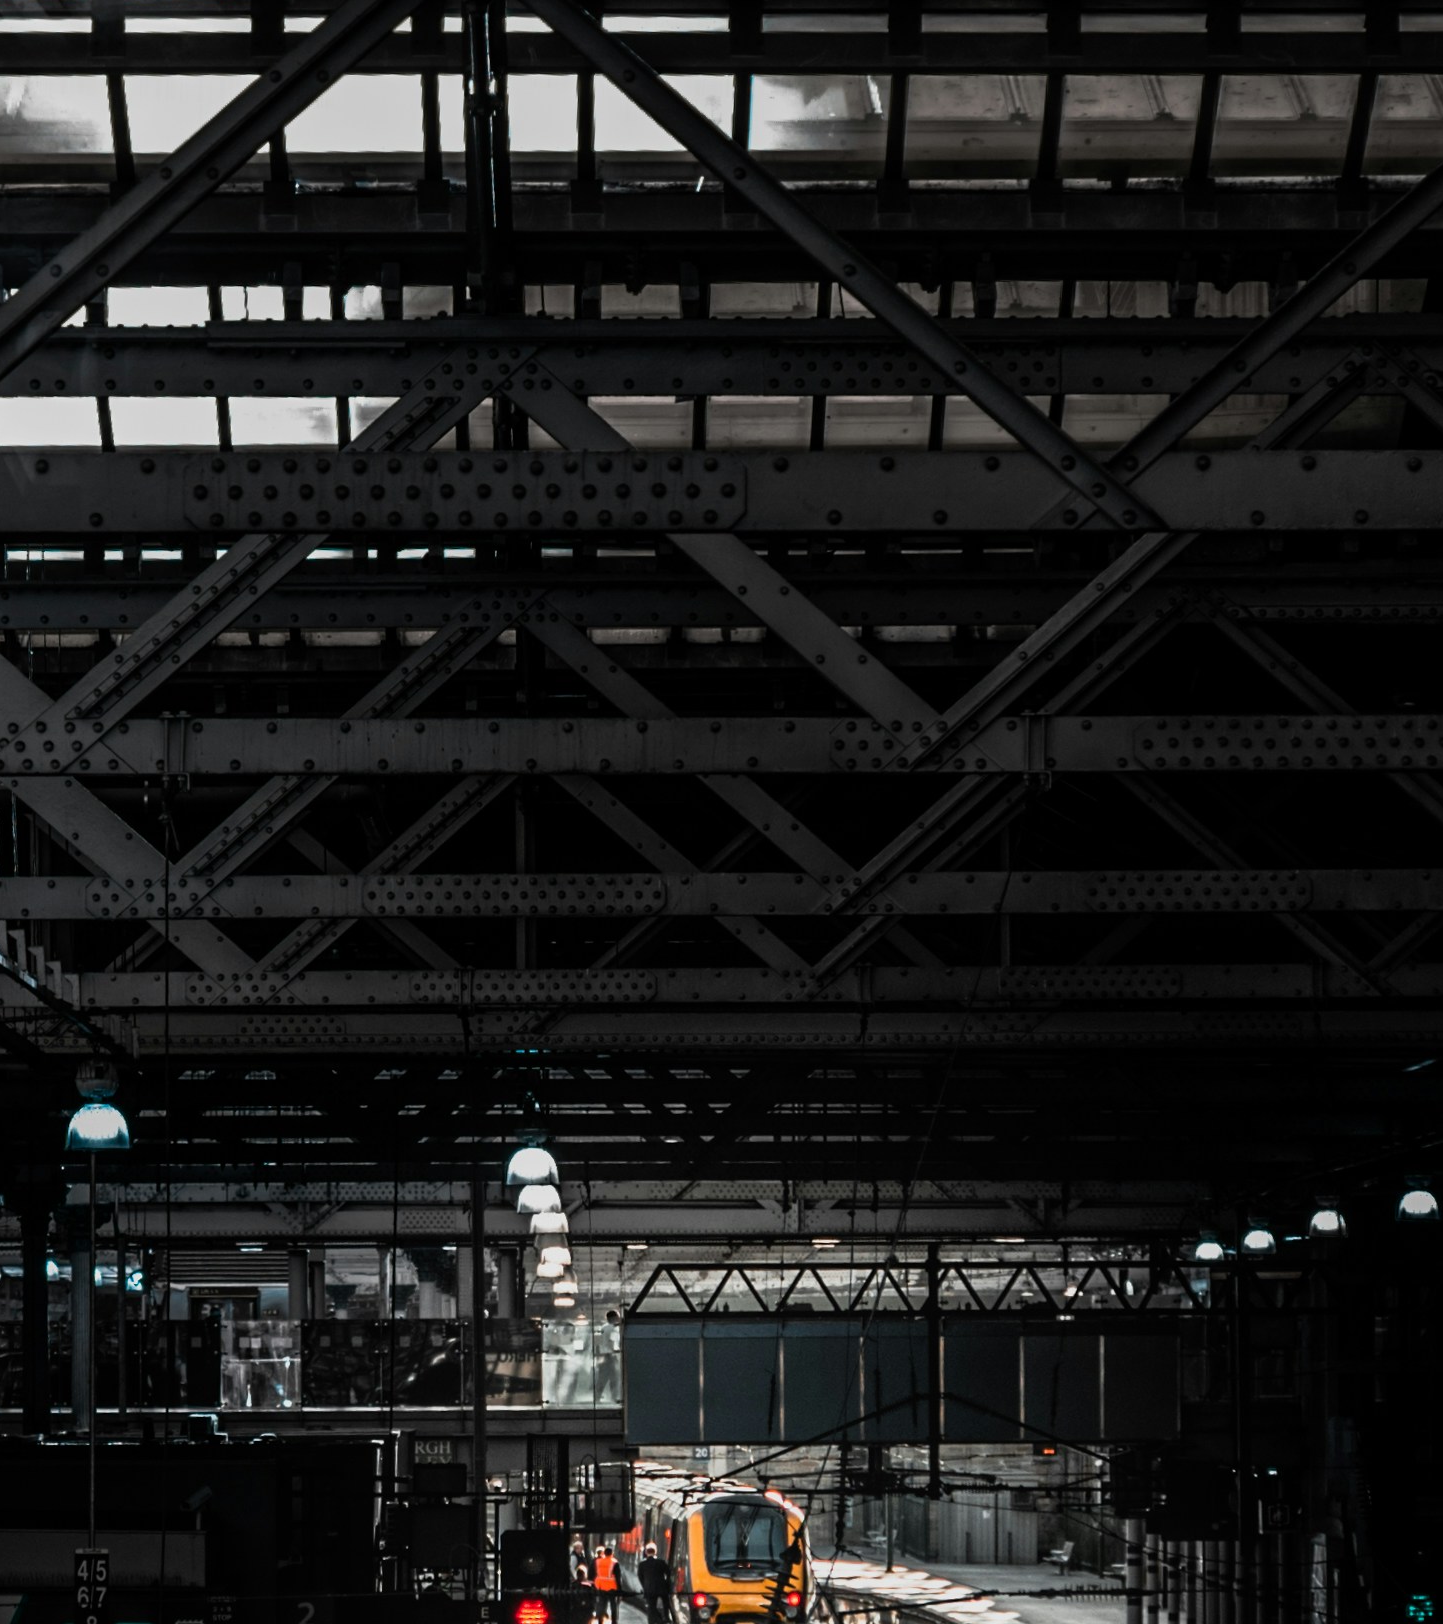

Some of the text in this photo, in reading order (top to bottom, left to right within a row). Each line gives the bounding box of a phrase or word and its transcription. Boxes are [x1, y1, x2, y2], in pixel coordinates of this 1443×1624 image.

[414, 1440, 452, 1455] RGH
[695, 1447, 709, 1458] 20
[480, 1606, 490, 1619] E
